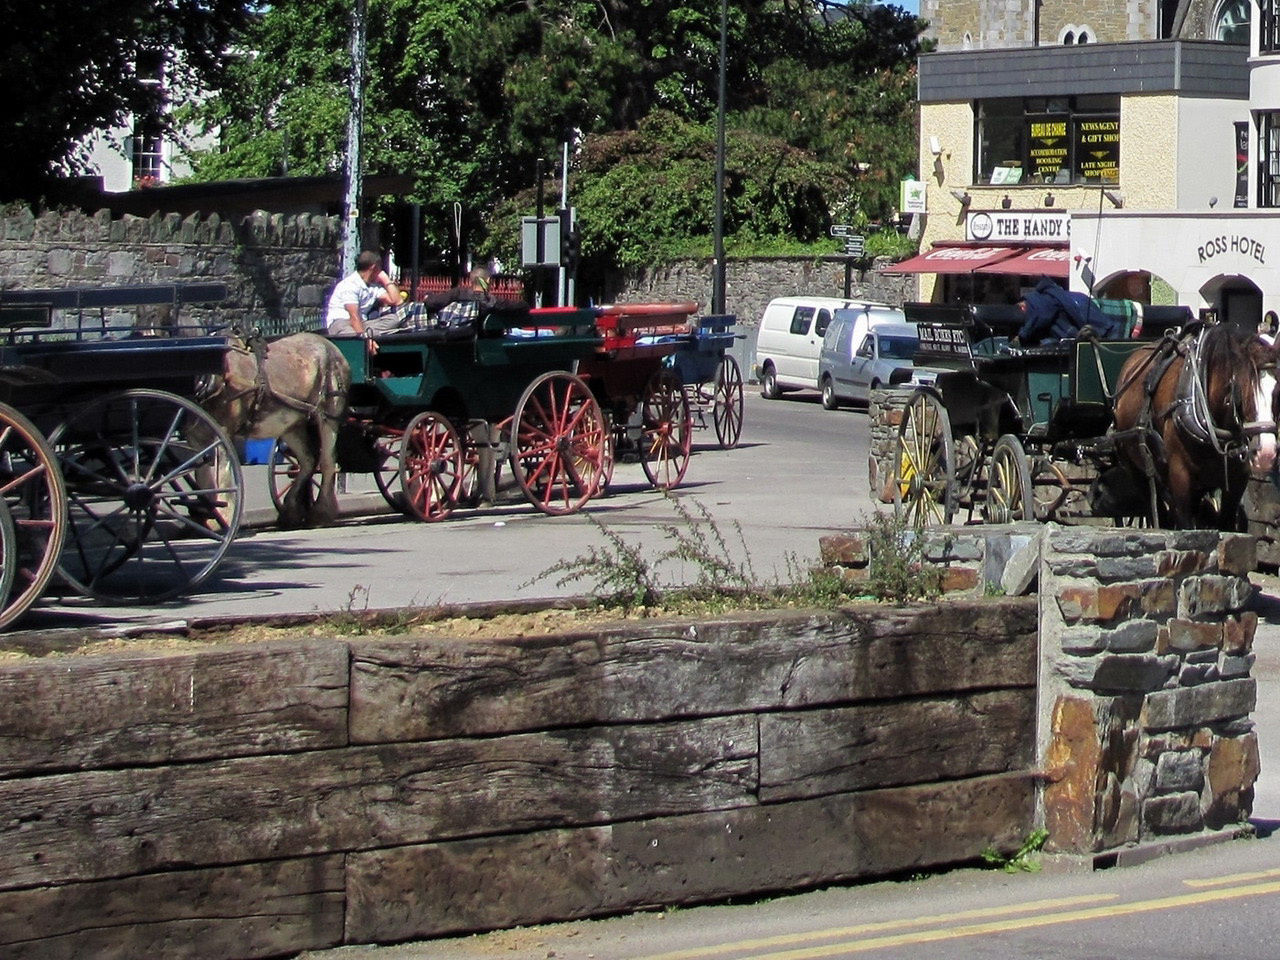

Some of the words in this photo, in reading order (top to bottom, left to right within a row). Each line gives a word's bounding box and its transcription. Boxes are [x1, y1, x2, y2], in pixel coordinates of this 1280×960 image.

[1081, 122, 1119, 131] NEWSAGENT
[1087, 134, 1102, 143] GIFT
[997, 219, 1019, 235] THE
[1023, 219, 1063, 236] HANDY
[1197, 235, 1227, 263] ROSS
[1231, 235, 1265, 264] HOTEL
